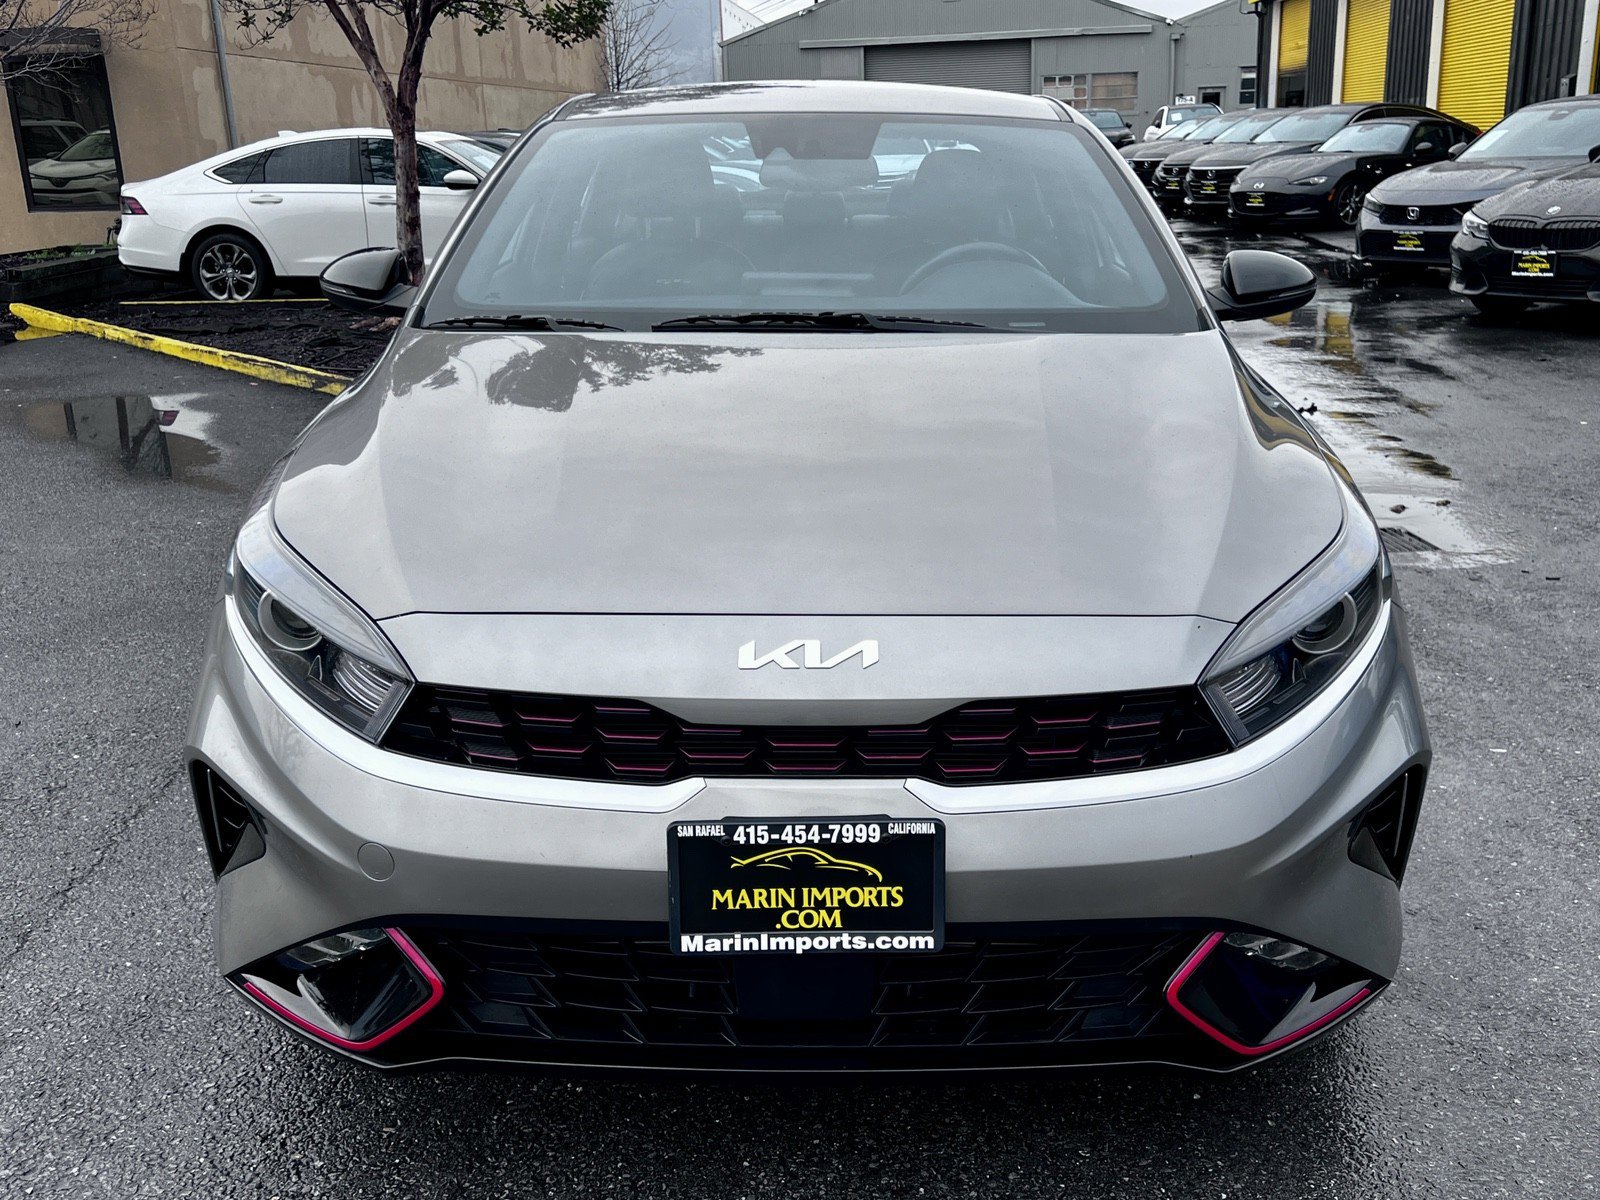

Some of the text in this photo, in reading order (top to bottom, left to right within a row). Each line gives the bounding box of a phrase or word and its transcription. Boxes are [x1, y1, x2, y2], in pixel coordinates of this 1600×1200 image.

[738, 639, 879, 669] KIA
[677, 825, 725, 837] SAN RAFAEL
[733, 824, 880, 844] 415-454-7999
[888, 823, 936, 834] CALIFORNIA
[712, 886, 904, 910] MARIN IMPORTS
[776, 909, 843, 929] .COM
[680, 933, 935, 955] MarinImports.com
